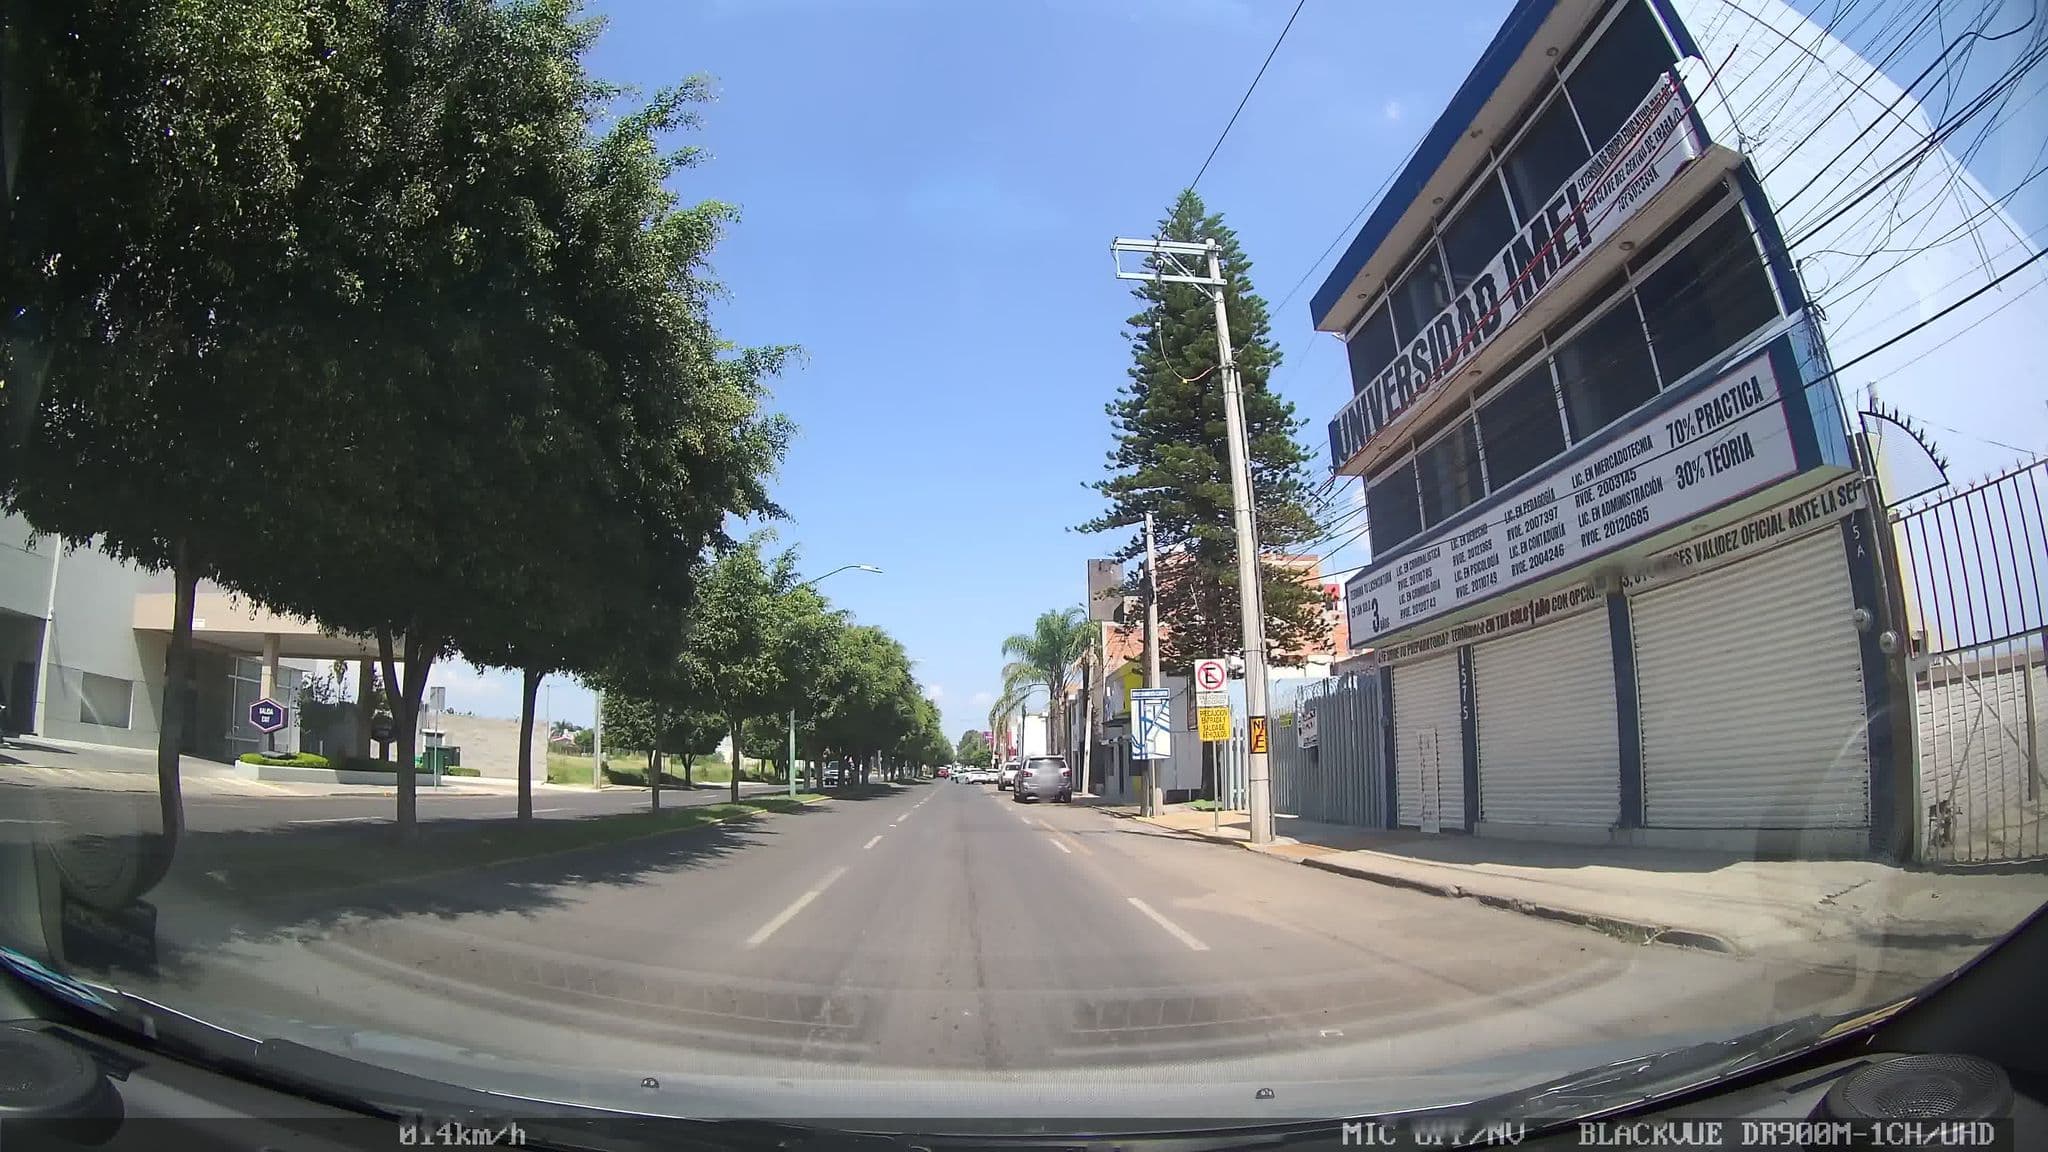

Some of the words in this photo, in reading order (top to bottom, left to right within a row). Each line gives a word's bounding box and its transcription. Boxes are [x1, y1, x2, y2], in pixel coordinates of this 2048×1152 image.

[1596, 176, 1616, 204] CLAVE
[1336, 273, 1501, 463] UNIVERSIDAD
[1503, 181, 1592, 311] IMEI
[1666, 413, 1696, 449] 70%
[1695, 376, 1764, 434] PRACTICA
[1571, 472, 1585, 489] LIC.
[1584, 464, 1595, 482] EN
[1593, 434, 1654, 478] MERCADOTECNIA
[1675, 454, 1706, 490] 30%
[1704, 432, 1755, 476] TEORIA
[1574, 487, 1596, 508] RVOE.
[1596, 469, 1637, 498] 2003145
[1577, 511, 1592, 528] LIC.
[1591, 503, 1602, 522] EN
[1600, 475, 1664, 518] ADMINISTRACIÓN
[1524, 506, 1558, 533] 2007397
[1580, 527, 1602, 548] RVOE.
[1603, 506, 1650, 538] 20120685
[1509, 544, 1521, 560] LIC.
[1520, 541, 1529, 555] EN
[1528, 543, 1565, 570] 2004246
[1551, 592, 1569, 612] CON
[1693, 529, 1740, 562] VALIDEZ
[1740, 511, 1786, 546] OFICIAL
[1787, 497, 1821, 529] ANTE
[1820, 490, 1838, 516] LA
[1371, 597, 1380, 633] 3
